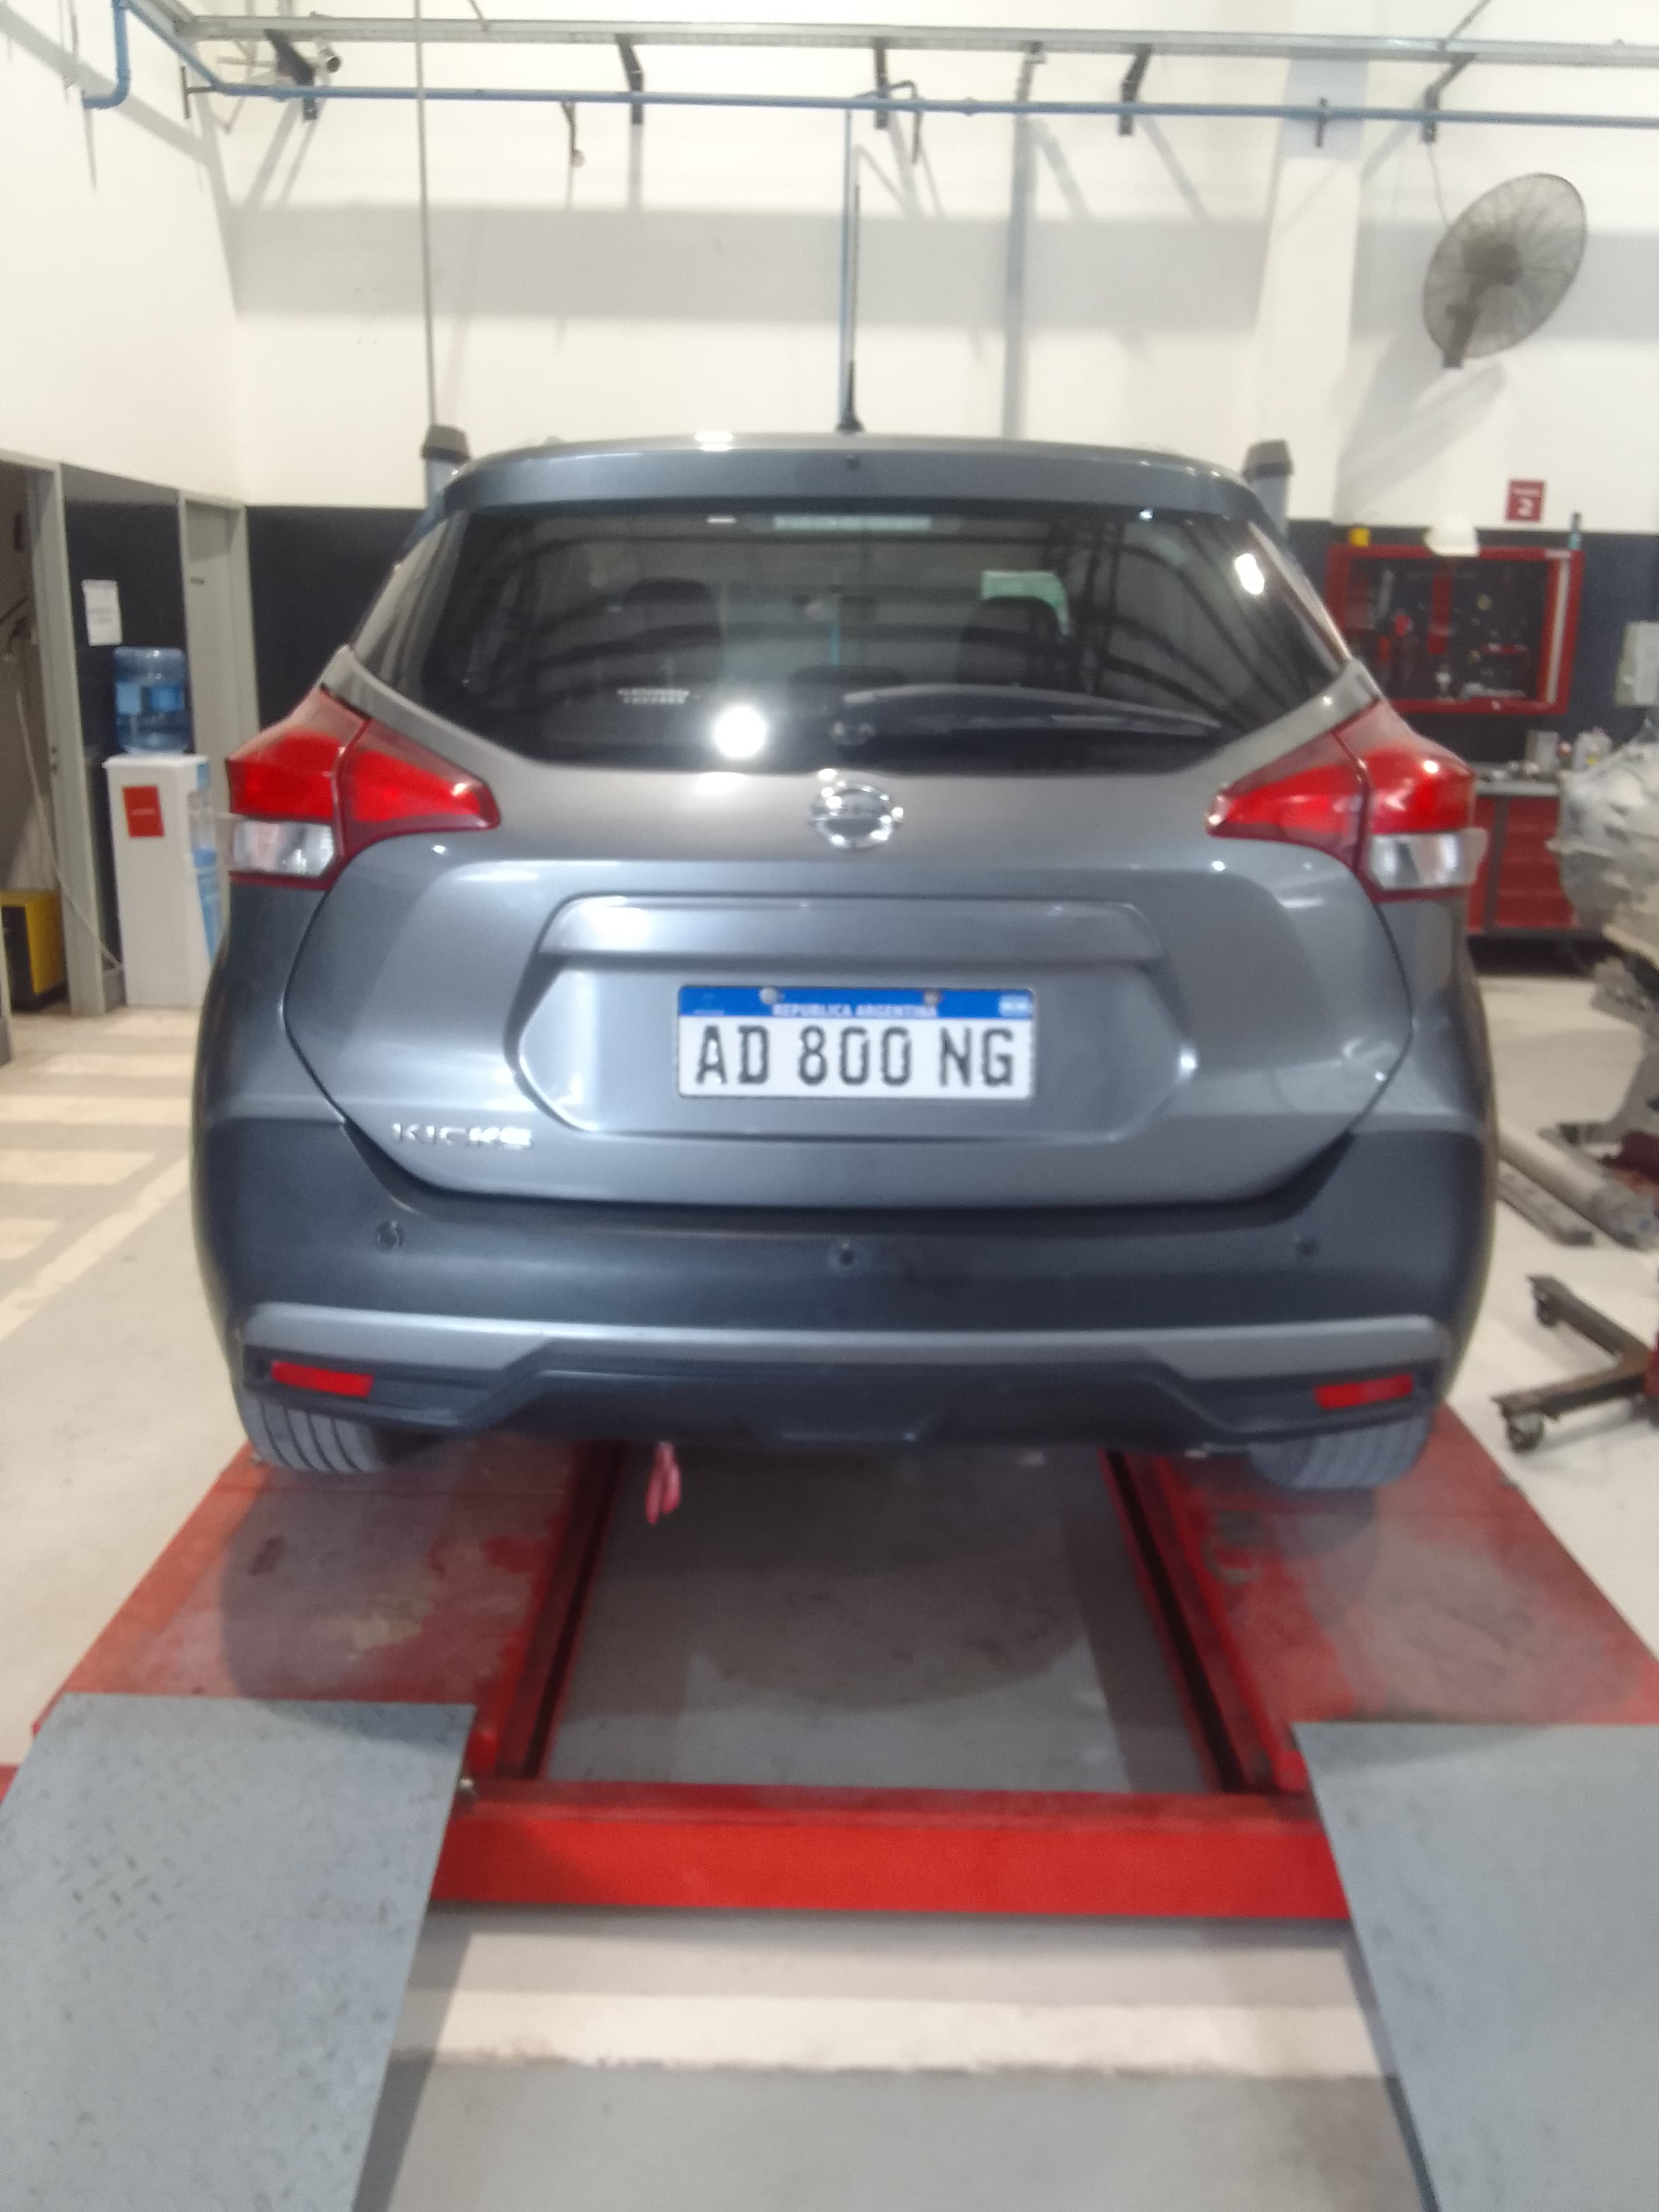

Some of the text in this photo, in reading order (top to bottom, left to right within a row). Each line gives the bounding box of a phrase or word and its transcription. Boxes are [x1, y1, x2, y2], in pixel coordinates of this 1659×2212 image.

[695, 1024, 1016, 1087] AD 800 NG
